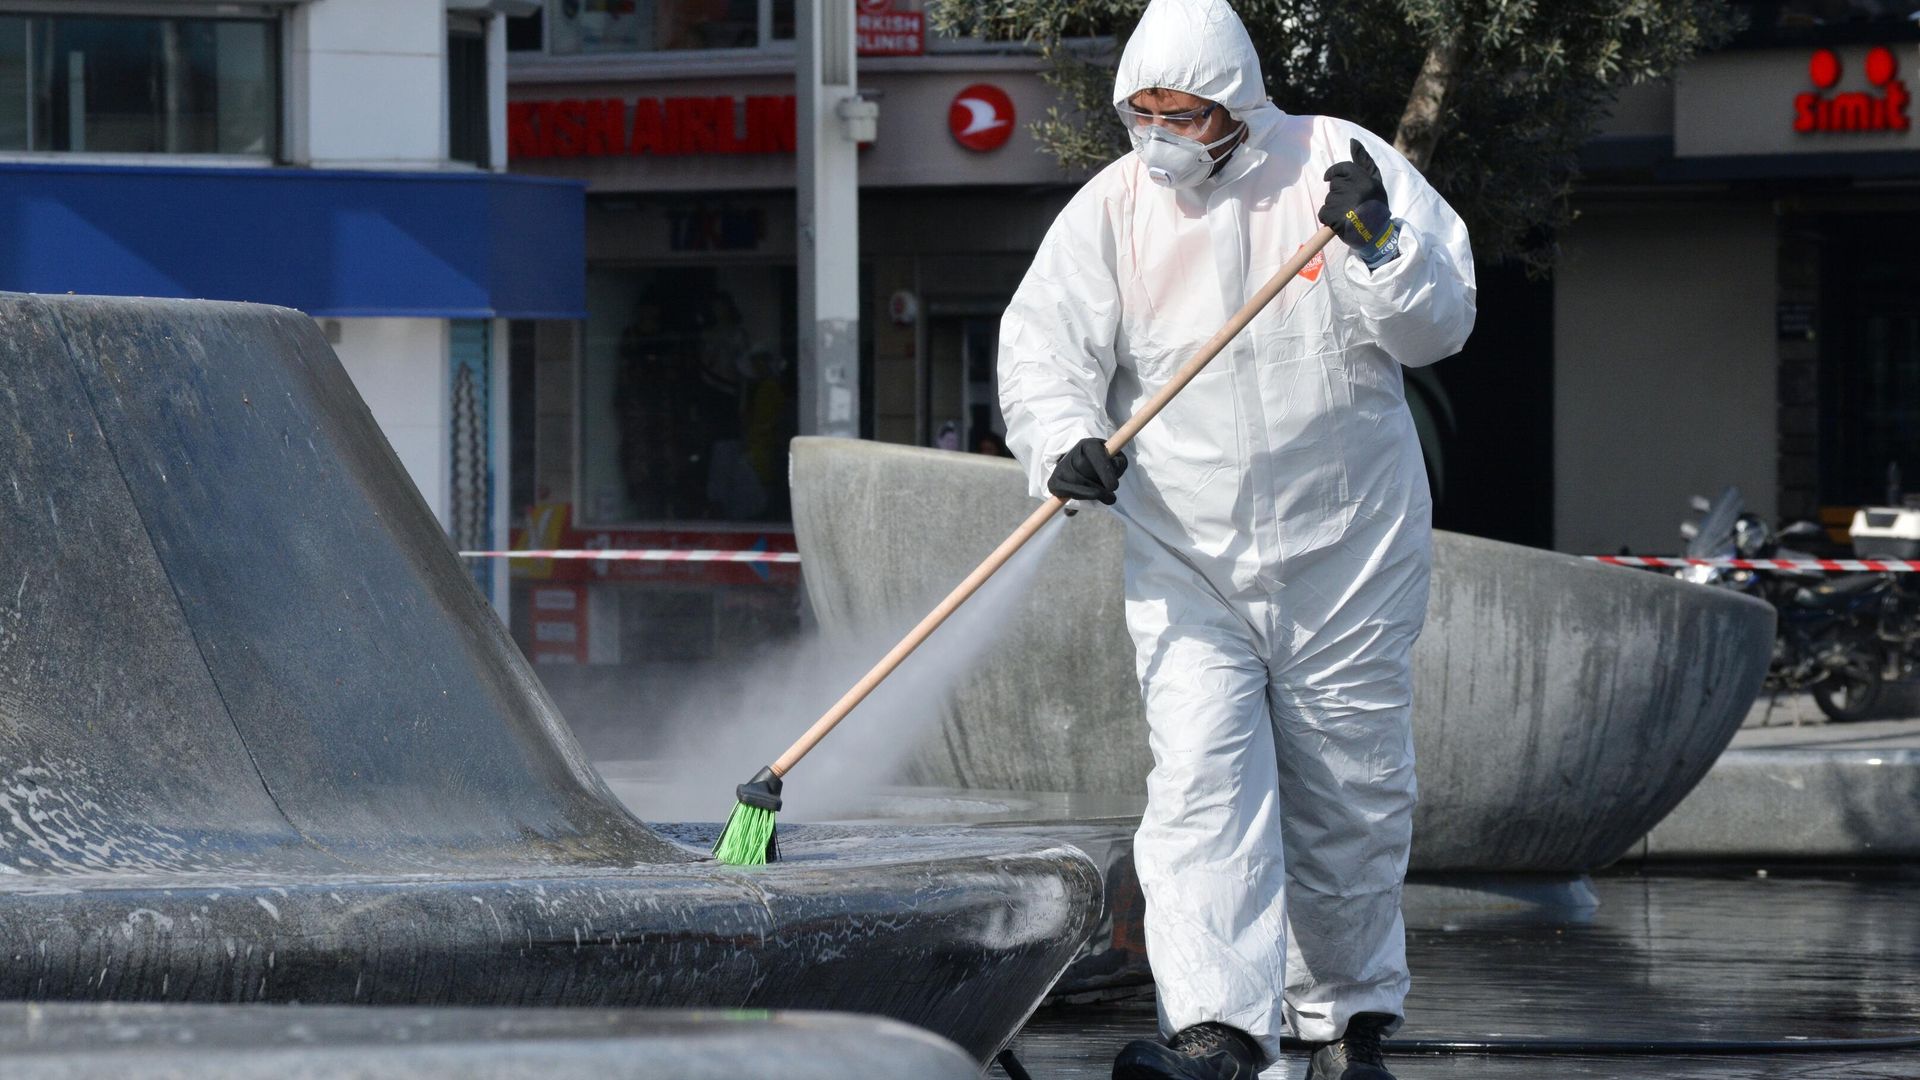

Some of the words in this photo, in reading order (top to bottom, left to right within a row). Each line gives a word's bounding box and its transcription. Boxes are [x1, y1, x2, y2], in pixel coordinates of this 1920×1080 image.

[856, 34, 919, 51] RLINES
[857, 15, 919, 32] RKISH
[1793, 46, 1909, 133] simit
[507, 99, 624, 157] KISH
[632, 94, 798, 155] AIRLIN
